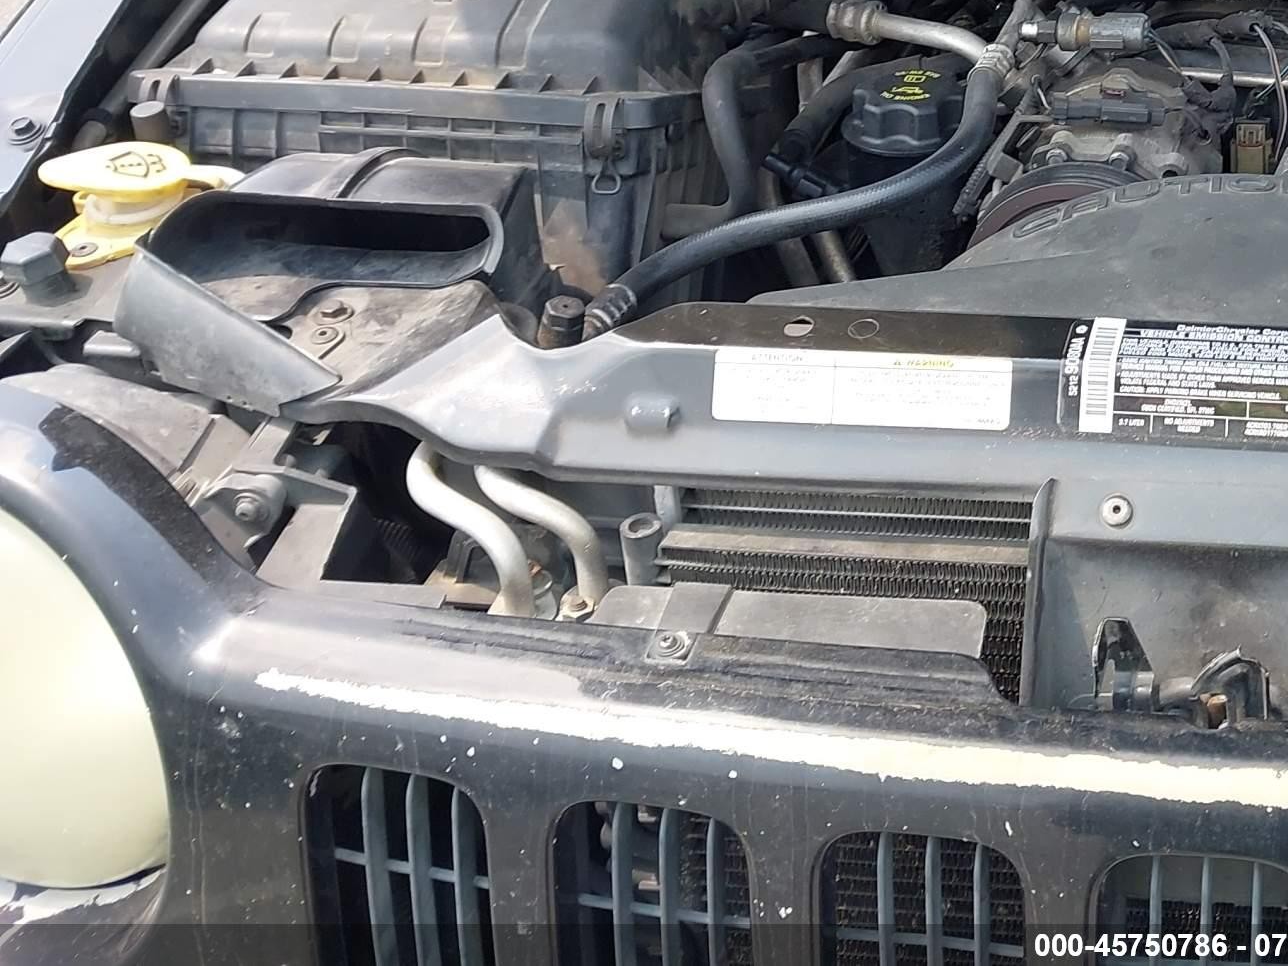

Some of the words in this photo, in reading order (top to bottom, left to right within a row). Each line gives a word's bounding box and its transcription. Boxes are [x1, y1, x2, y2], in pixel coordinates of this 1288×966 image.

[1139, 330, 1186, 339] VEHICLE
[1188, 331, 1244, 342] EMISSION
[1176, 324, 1260, 336] DaimlerChrysler
